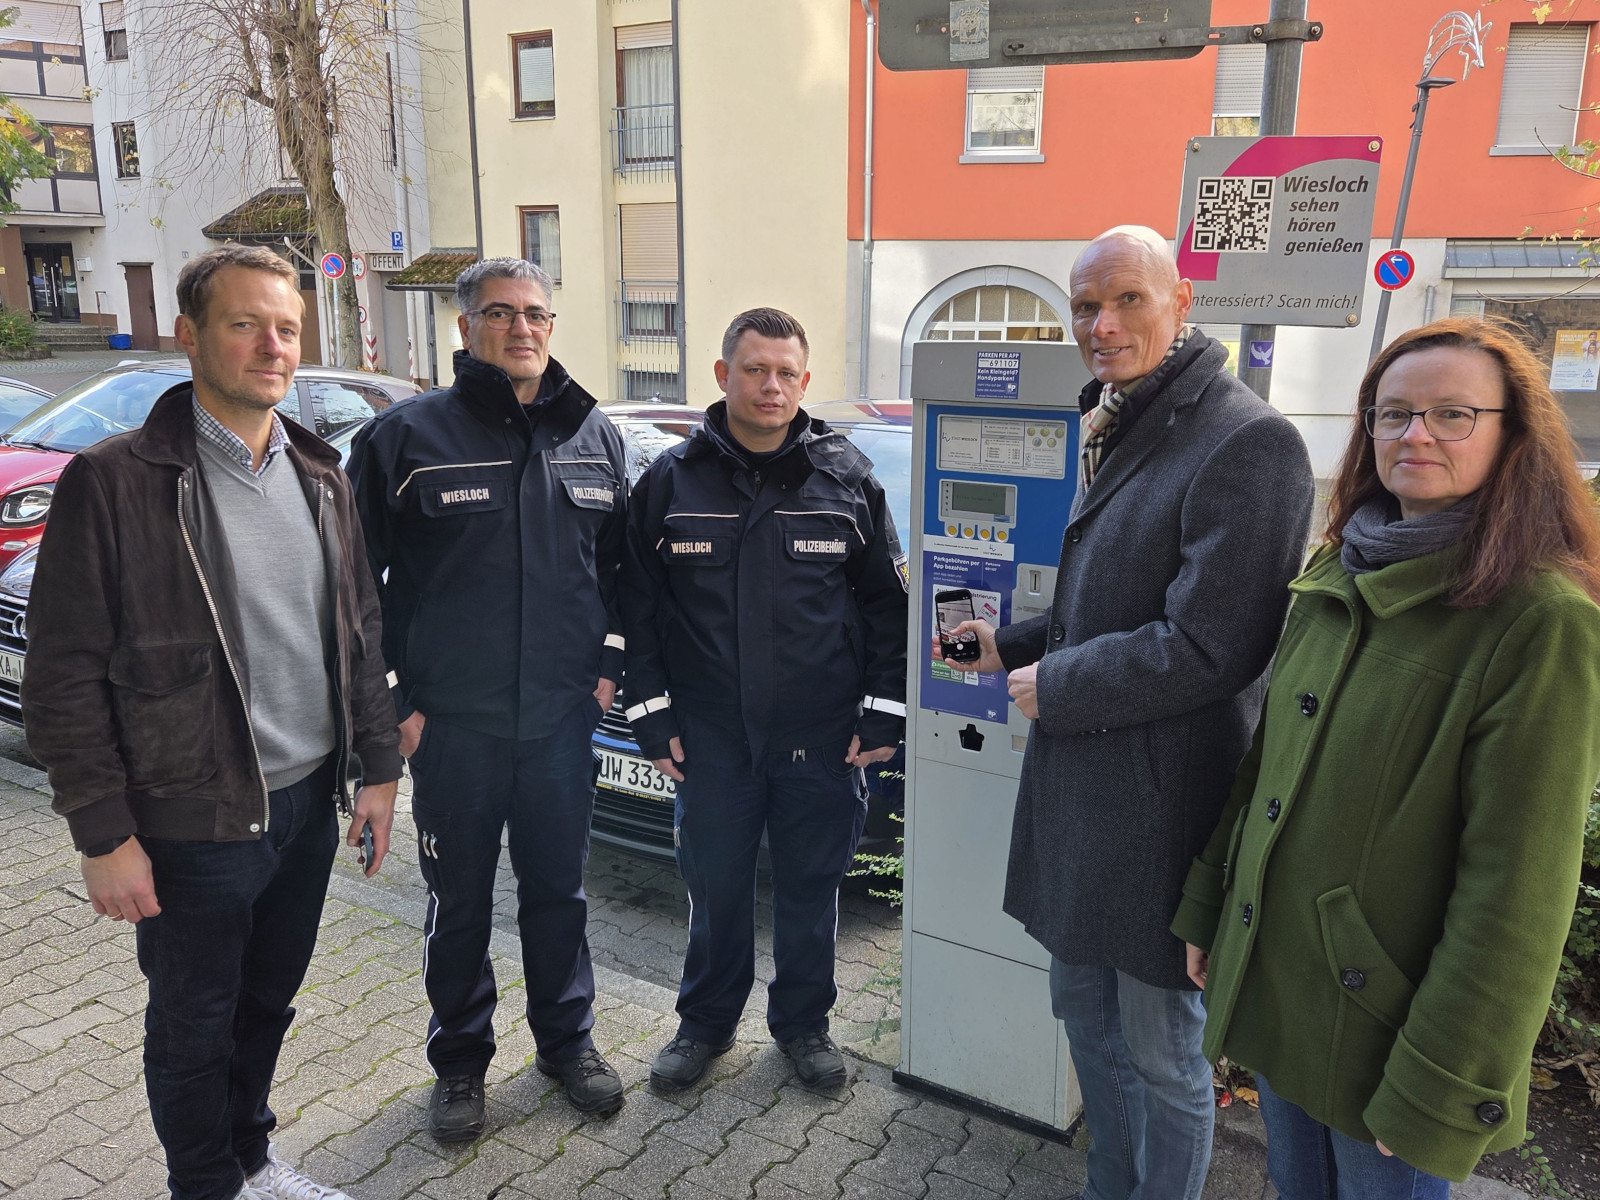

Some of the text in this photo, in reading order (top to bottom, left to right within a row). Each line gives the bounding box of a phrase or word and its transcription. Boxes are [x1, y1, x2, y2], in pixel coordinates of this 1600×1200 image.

[1283, 175, 1369, 193] Wiesloch
[1289, 197, 1339, 212] sehen
[1287, 217, 1336, 233] hören
[393, 232, 401, 246] P
[1284, 237, 1364, 256] genießen
[1191, 293, 1358, 309] nteressiert? Scan mich!
[440, 487, 490, 504] WIESLOCH
[671, 541, 712, 554] WIESLOCH
[933, 555, 969, 565] Parkgebühren
[945, 564, 968, 572] bezahlen
